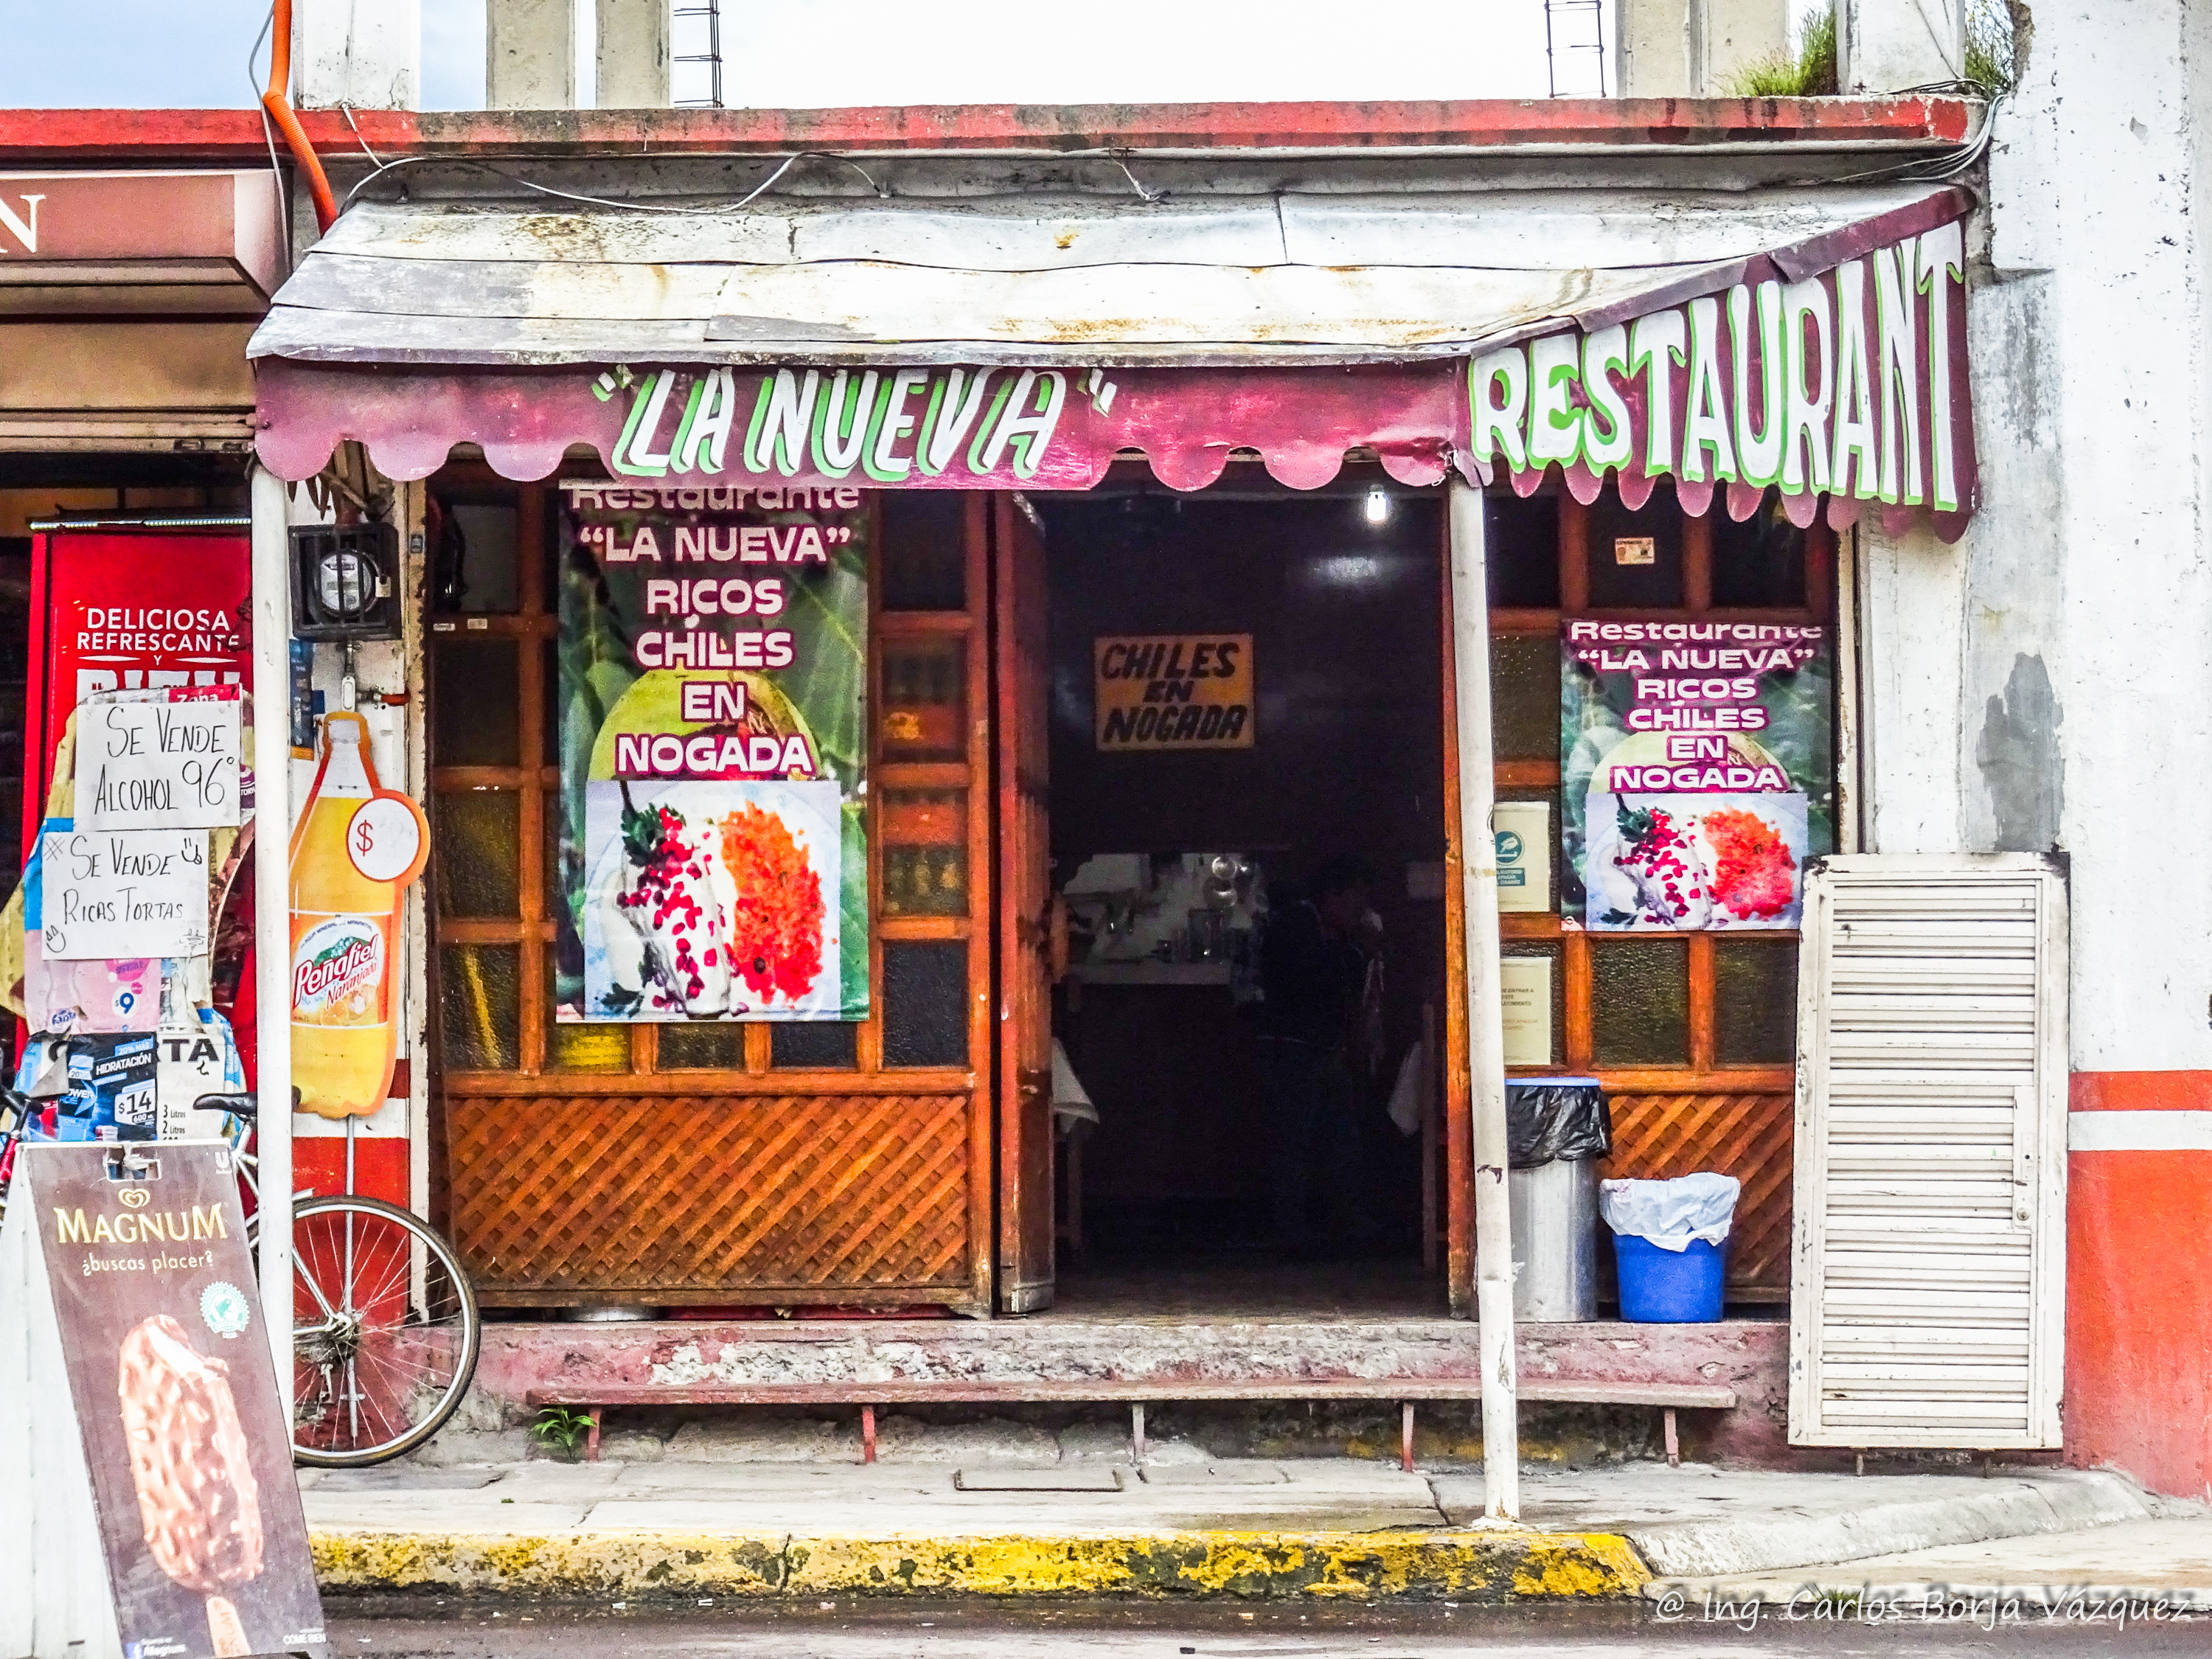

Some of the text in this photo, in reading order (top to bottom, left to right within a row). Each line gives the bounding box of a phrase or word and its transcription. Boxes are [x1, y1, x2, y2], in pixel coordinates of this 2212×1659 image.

[1468, 220, 1965, 513] RESTAURANT
[647, 579, 784, 615] RICOS
[87, 608, 231, 632] DELICIOSA
[1571, 622, 1822, 641] Restaurante
[77, 632, 240, 653] REFRESCANTE
[153, 655, 163, 666] Y
[636, 631, 794, 667] CHILES
[1101, 642, 1241, 679] CHILES
[684, 684, 745, 720] EN
[1144, 681, 1194, 703] EN
[1638, 678, 1757, 700] RICOS
[107, 706, 227, 757] SE VENDE
[1103, 705, 1248, 742] NOGADA
[1628, 708, 1766, 729] CHILES
[618, 737, 813, 773] NOGADA
[1671, 738, 1724, 759] EN
[94, 764, 179, 815] ALCOHOL
[1614, 768, 1784, 789] NOGADA
[111, 838, 178, 876] VENDE
[63, 886, 184, 925] RICAS TORTAS
[292, 933, 380, 1011] Peñafiel
[324, 960, 378, 1010] Naranjada
[96, 1052, 152, 1076] HIDRATACIÓN
[162, 1120, 168, 1134] 2
[170, 1125, 185, 1134] Litros
[163, 1105, 186, 1119] 3 Litros
[53, 1203, 229, 1245] MAGNUM
[82, 1250, 214, 1276] ¿buscas placer?
